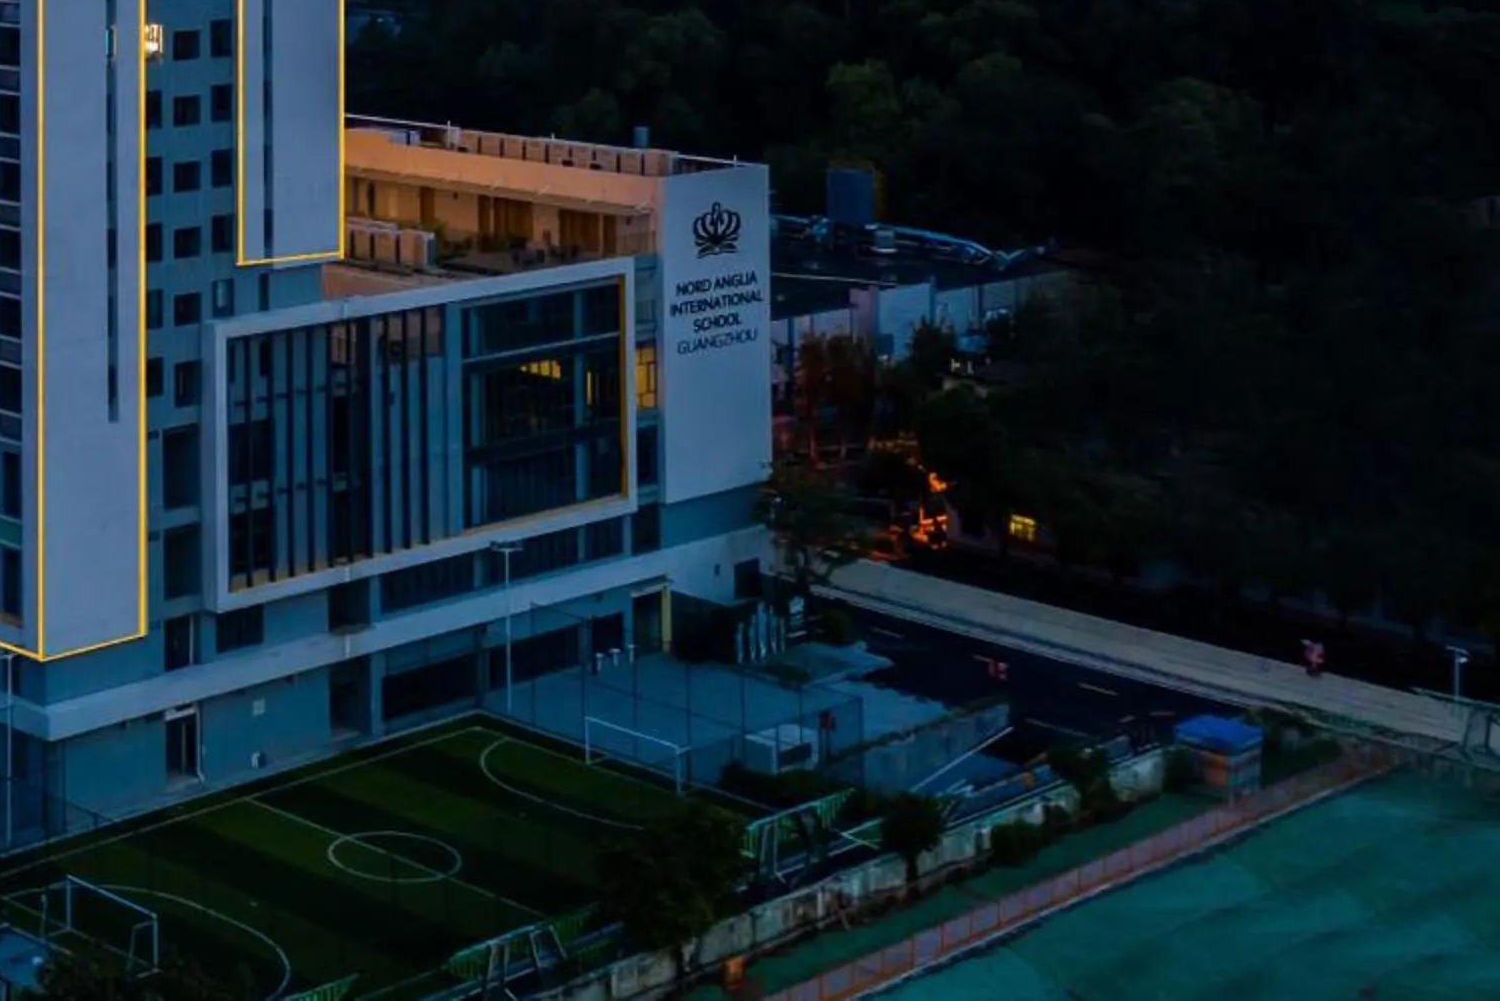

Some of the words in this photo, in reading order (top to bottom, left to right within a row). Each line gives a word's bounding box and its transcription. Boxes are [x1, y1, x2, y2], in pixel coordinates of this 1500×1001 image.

[675, 278, 712, 296] NORD
[713, 270, 758, 291] ANGLIA
[670, 289, 764, 317] INTERNATIONAL
[692, 312, 742, 333] SCHOOL
[677, 327, 758, 355] GUANGZHOU
